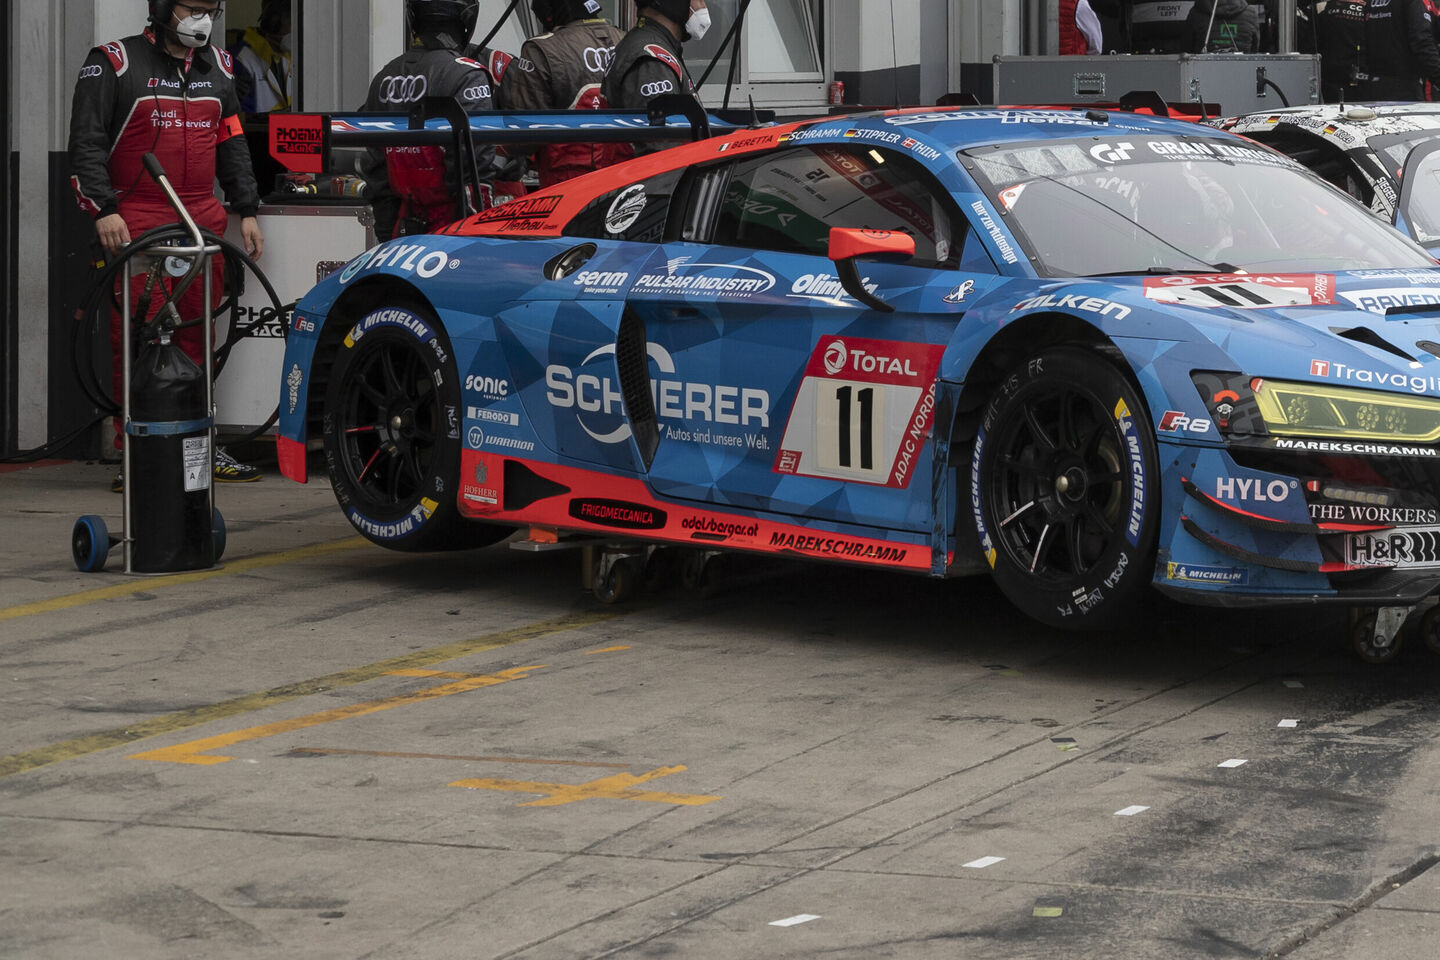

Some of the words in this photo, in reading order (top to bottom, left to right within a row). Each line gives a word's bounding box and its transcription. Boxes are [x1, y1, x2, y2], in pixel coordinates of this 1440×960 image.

[151, 109, 177, 119] Audi
[789, 128, 842, 142] SCHRAMM
[856, 128, 901, 145] STIPPLER
[1151, 141, 1208, 157] GRAN
[478, 195, 561, 220] SCHRAMM
[574, 271, 629, 287] serim
[635, 275, 693, 289] PULSAR
[693, 276, 767, 292] INDUSTRY
[1191, 285, 1274, 306] 11
[1009, 294, 1132, 321] FALKEN
[364, 309, 428, 339] MICHELIN
[850, 349, 918, 376] TOTAL
[477, 408, 509, 423] FERODO
[666, 425, 691, 441] Autos
[692, 429, 711, 443] sind
[713, 433, 742, 448] unsere
[745, 433, 770, 451] Welt.
[836, 385, 873, 470] 11
[485, 435, 535, 451] WARRIOR
[1276, 439, 1437, 456] MAREKSCHRAMM
[894, 440, 916, 485] ADAC
[464, 485, 497, 498] HOFHERR
[971, 435, 983, 532] MICHELIN
[1127, 436, 1144, 537] MICHELIN
[581, 502, 654, 525] FRIGOMECCANICA
[1308, 504, 1345, 519] THE
[1351, 507, 1437, 523] WORKERS
[352, 513, 412, 538] MICHELIN
[769, 531, 907, 563] MAREKSCHRAMM
[1349, 534, 1410, 563] H&R
[1189, 571, 1241, 581] MICHELIN
